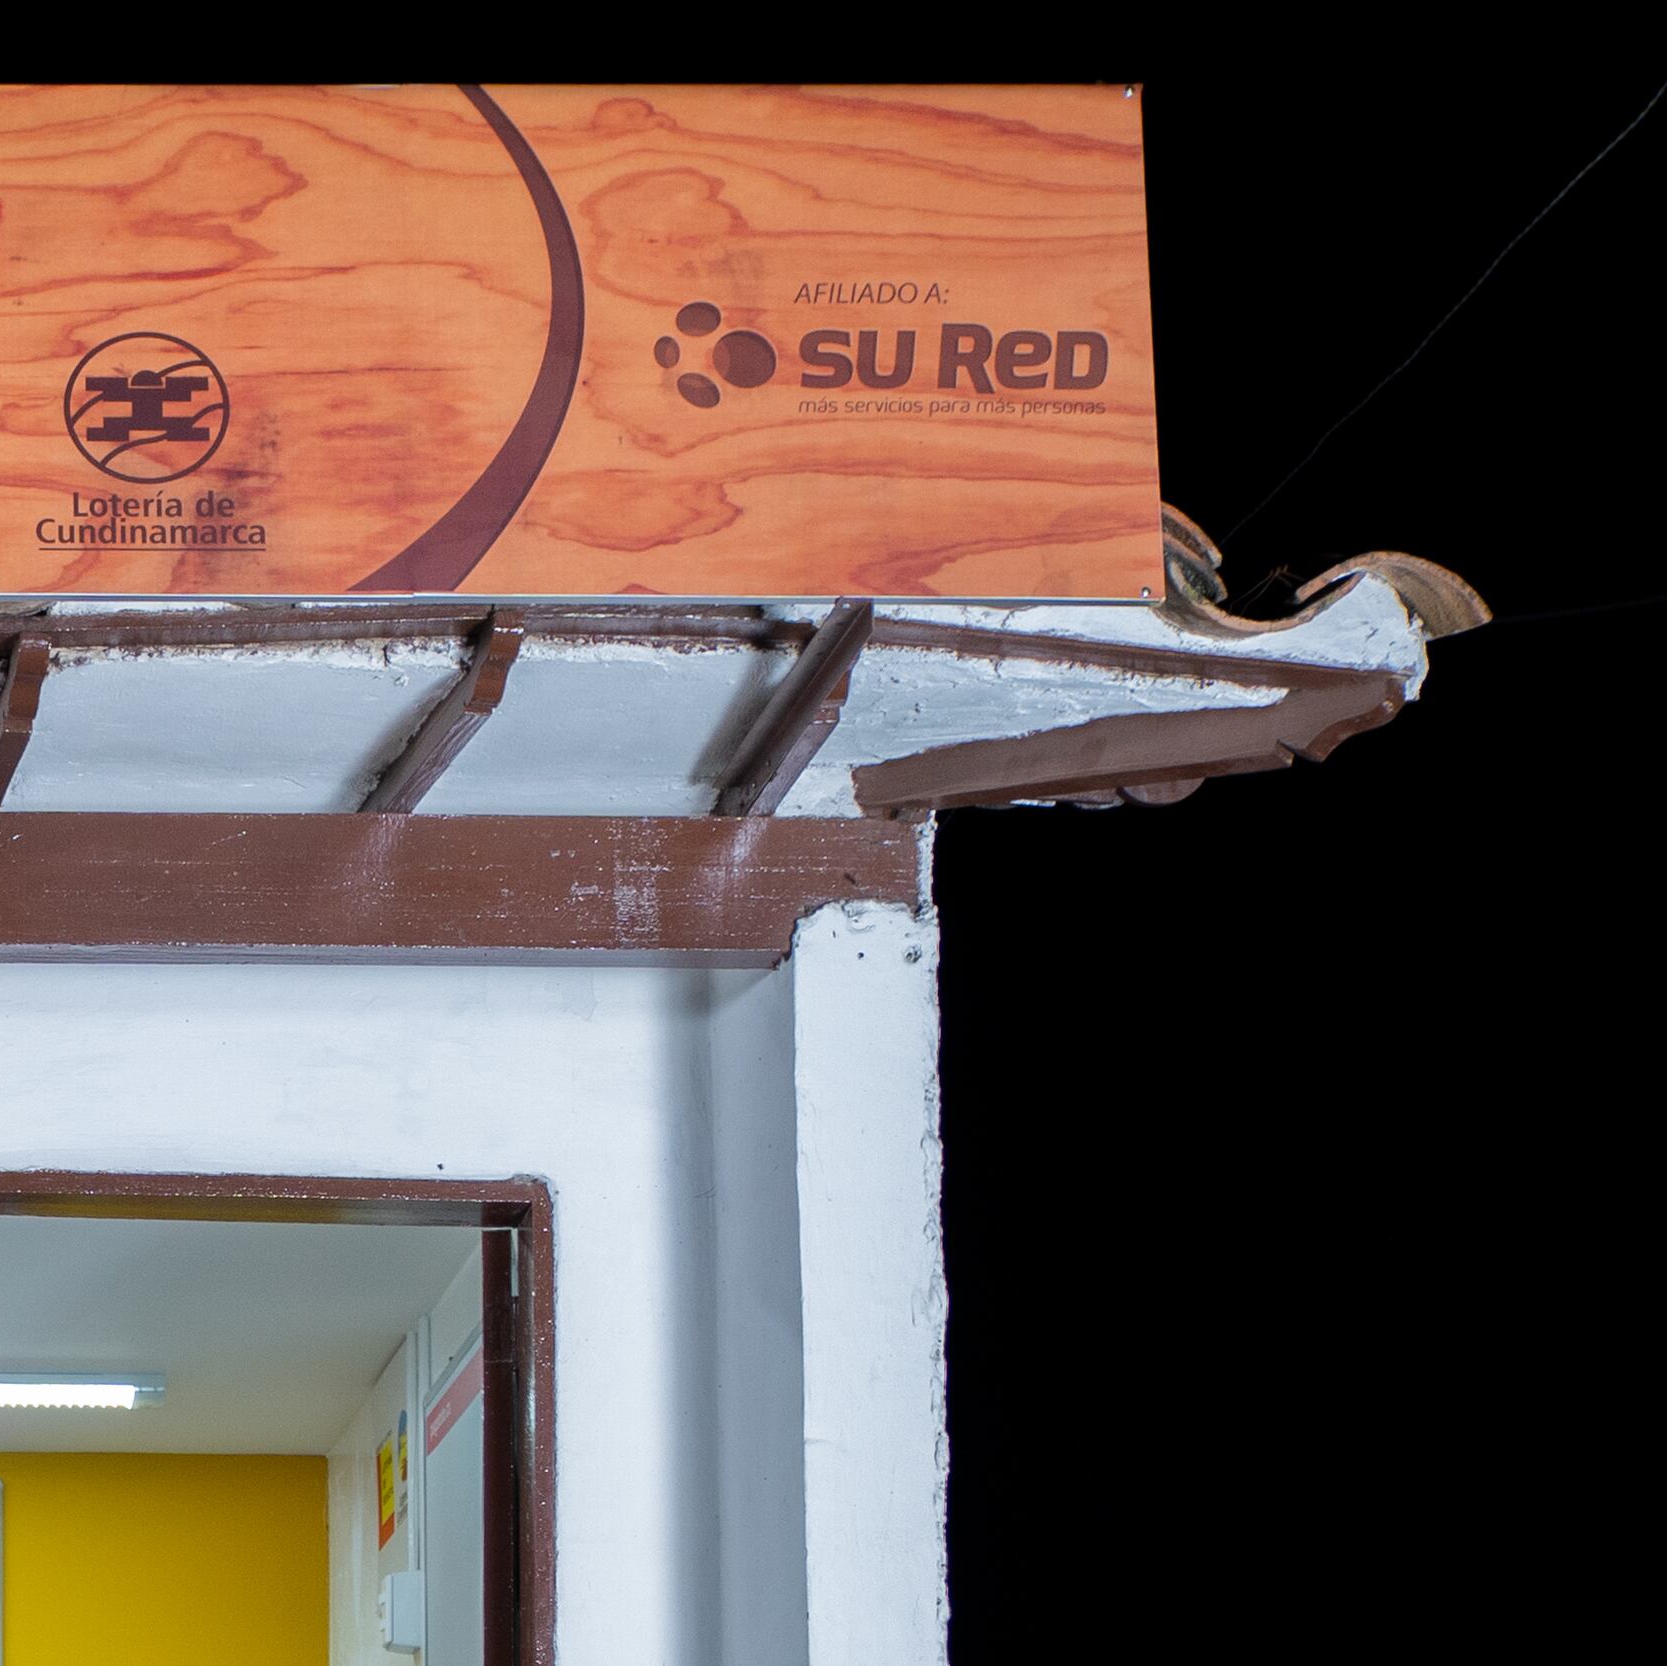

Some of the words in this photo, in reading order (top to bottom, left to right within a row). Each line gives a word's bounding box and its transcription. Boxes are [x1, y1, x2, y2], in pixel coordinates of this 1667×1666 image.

[793, 282, 918, 305] AFILIADO
[923, 282, 950, 305] A:
[798, 398, 838, 414] más
[844, 397, 923, 414] servicios
[929, 400, 971, 418] para
[976, 397, 1016, 414] más
[1021, 399, 1106, 418] personas
[72, 490, 183, 518] Lotería
[195, 490, 236, 518] de
[35, 518, 267, 545] Cundinamarca
